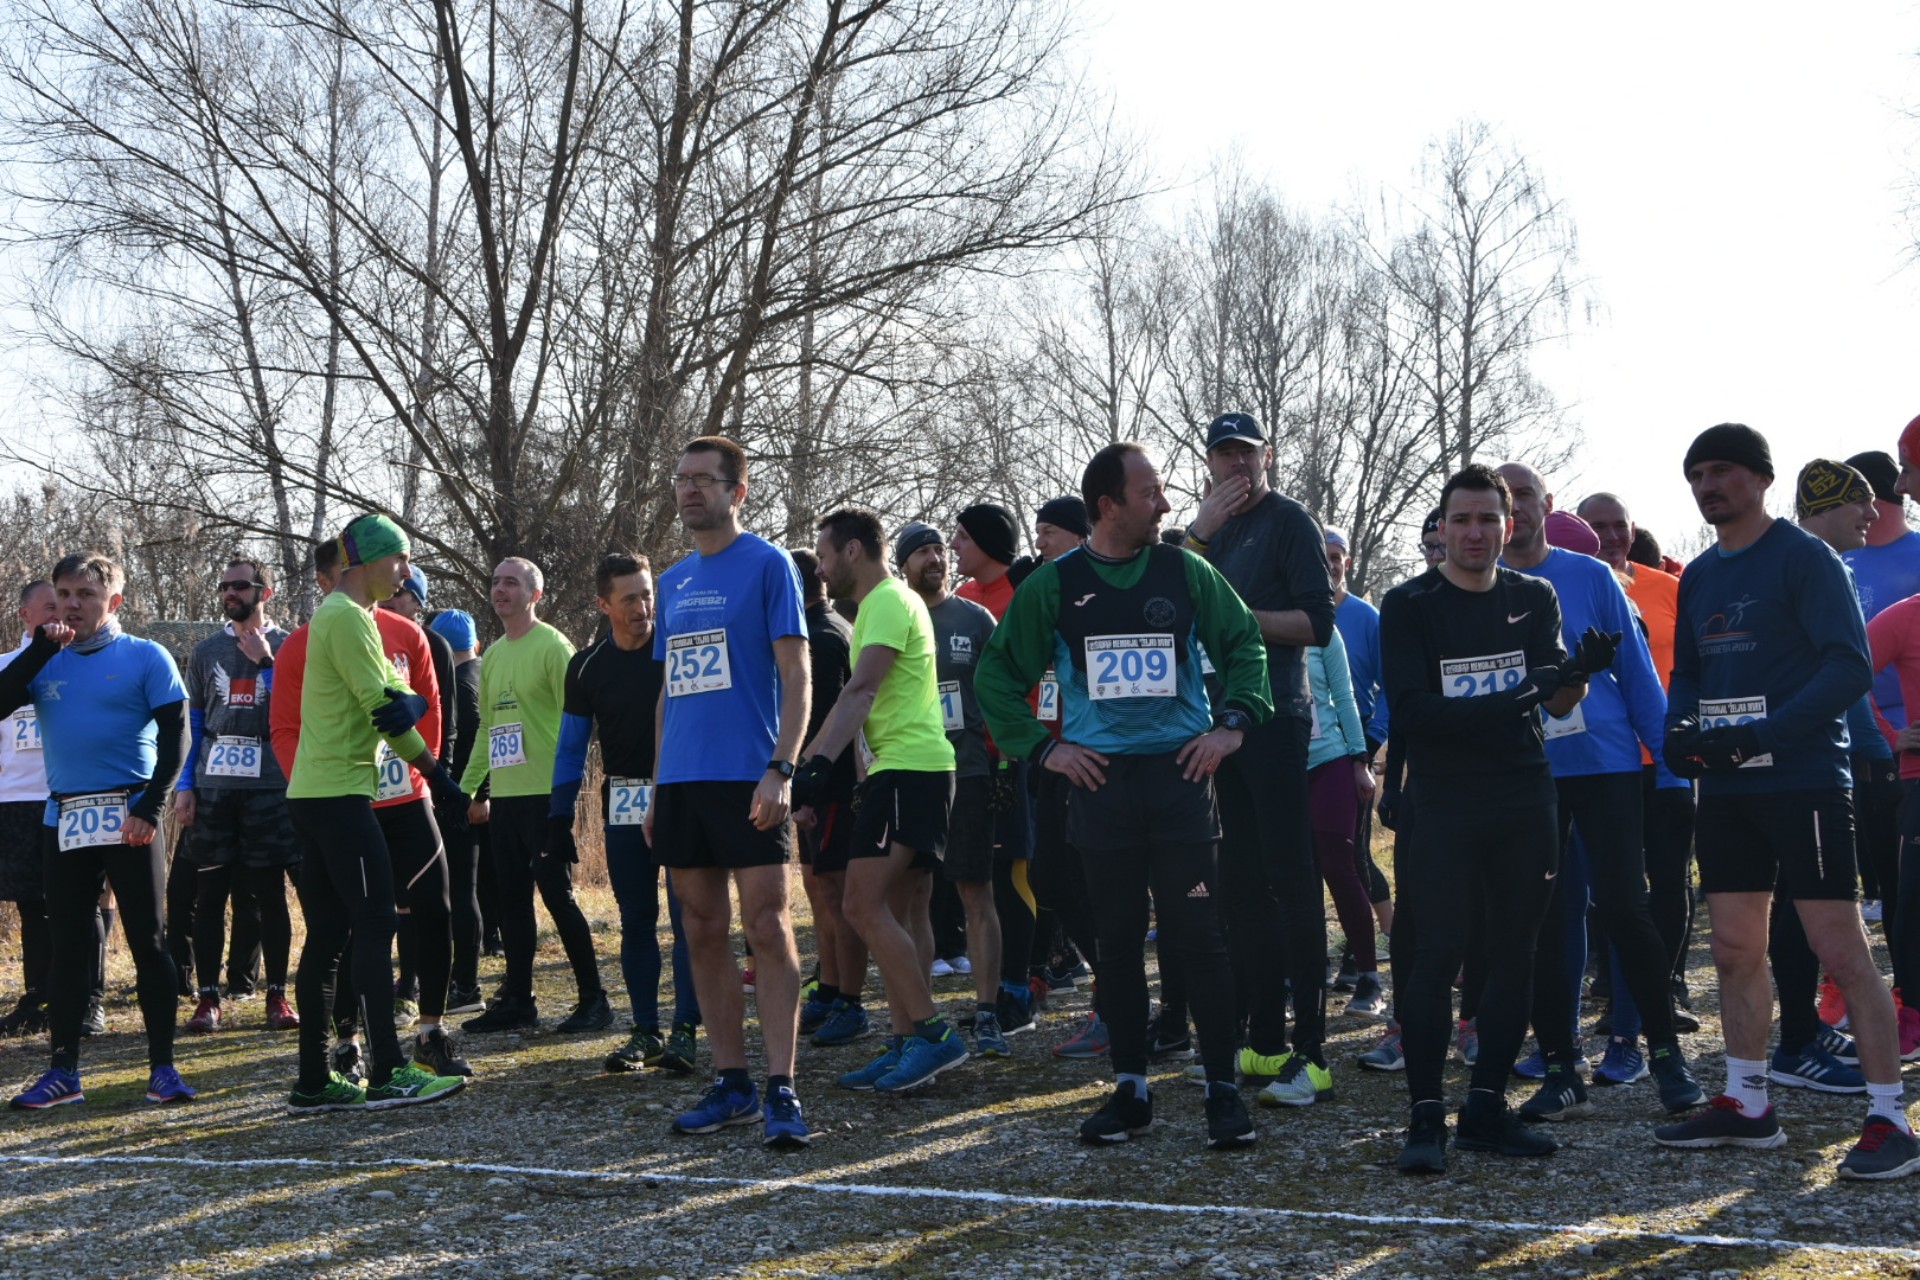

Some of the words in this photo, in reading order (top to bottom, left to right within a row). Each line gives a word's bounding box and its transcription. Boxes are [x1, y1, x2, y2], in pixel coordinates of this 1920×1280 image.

[669, 646, 723, 681] 252
[1096, 650, 1168, 684] 209
[230, 693, 253, 703] EKO
[1039, 683, 1055, 708] 2
[16, 720, 41, 740] 21
[212, 745, 256, 767] 268
[492, 734, 519, 758] 269
[616, 786, 653, 813] 24
[64, 806, 122, 837] 205
